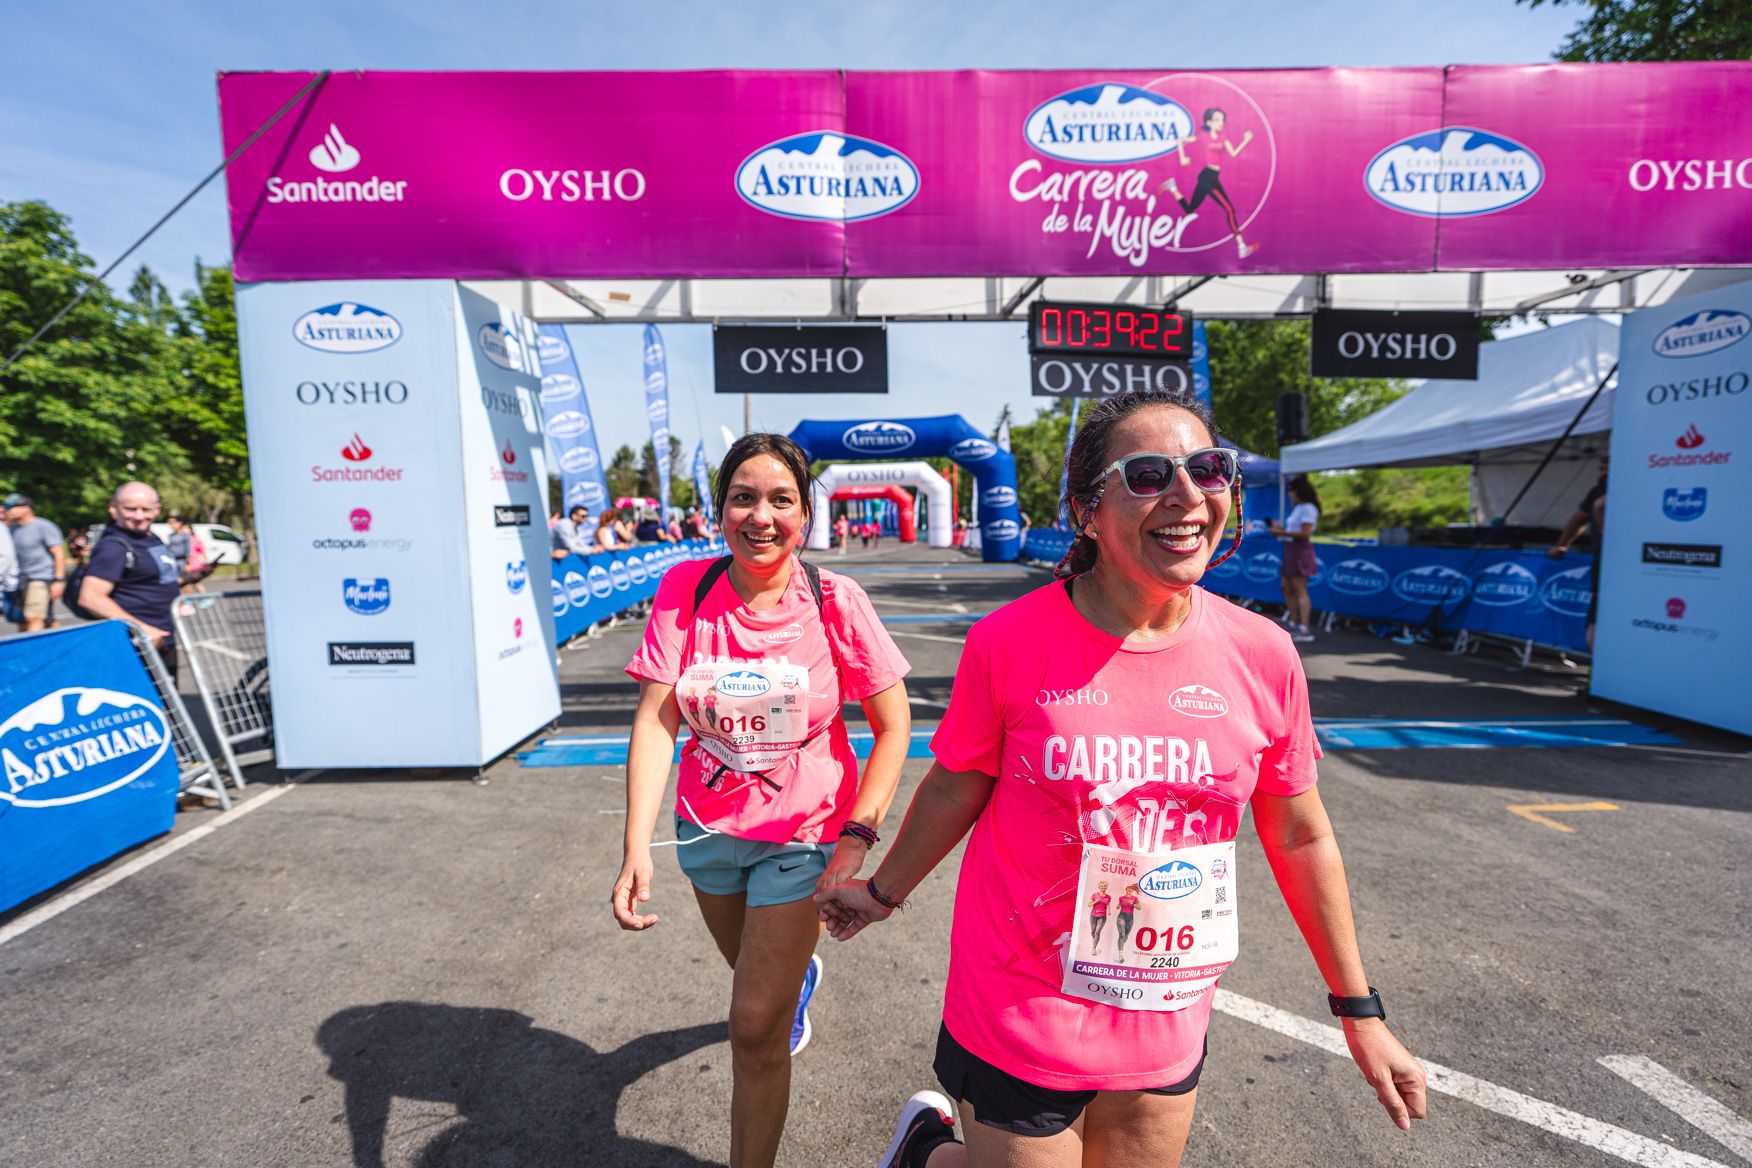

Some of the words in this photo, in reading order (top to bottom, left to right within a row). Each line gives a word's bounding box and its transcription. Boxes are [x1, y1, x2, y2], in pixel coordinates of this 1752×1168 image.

[1039, 113, 1179, 144] ASTURIANA
[500, 168, 646, 202] OYSHO
[752, 163, 905, 198] ASTURIANA
[1009, 158, 1149, 203] Carrera
[1379, 160, 1527, 194] ASTURIANA
[266, 176, 408, 204] Santander
[1042, 203, 1069, 233] de
[1073, 201, 1094, 233] la
[1086, 194, 1199, 267] Mujer
[302, 320, 395, 341] ASTURIANA
[1041, 308, 1183, 352] 00:39:22
[1661, 324, 1745, 351] ASTURIANA
[1337, 330, 1457, 361] OYSHO
[740, 347, 865, 375] OYSHO
[1038, 359, 1189, 395] OYSHO
[1646, 371, 1750, 406] OYSHO
[296, 380, 409, 405] OYSHO
[1648, 451, 1733, 469] Santander
[311, 466, 404, 483] Santander
[848, 469, 905, 482] OYSHO
[332, 645, 411, 664] Neutrogena
[690, 673, 714, 681] SUMA
[720, 680, 767, 691] ASTURIANA
[1035, 689, 1109, 706] OYSHO
[1173, 695, 1225, 712] ASTURIANA
[720, 715, 766, 734] 016
[732, 735, 755, 745] 2239
[2, 720, 163, 794] ASTURIANA
[1043, 734, 1216, 786] CARRERA
[1101, 862, 1137, 878] SUMA
[1112, 857, 1138, 867] DORSAL
[1144, 876, 1199, 891] ASTURIANA
[1135, 925, 1195, 952] 016
[1076, 964, 1115, 977] CARRERA
[1117, 968, 1128, 978] DE
[1129, 971, 1140, 980] LA
[1141, 972, 1169, 981] MUJER
[1150, 956, 1180, 968] 2240
[1088, 982, 1144, 1001] OYSHO
